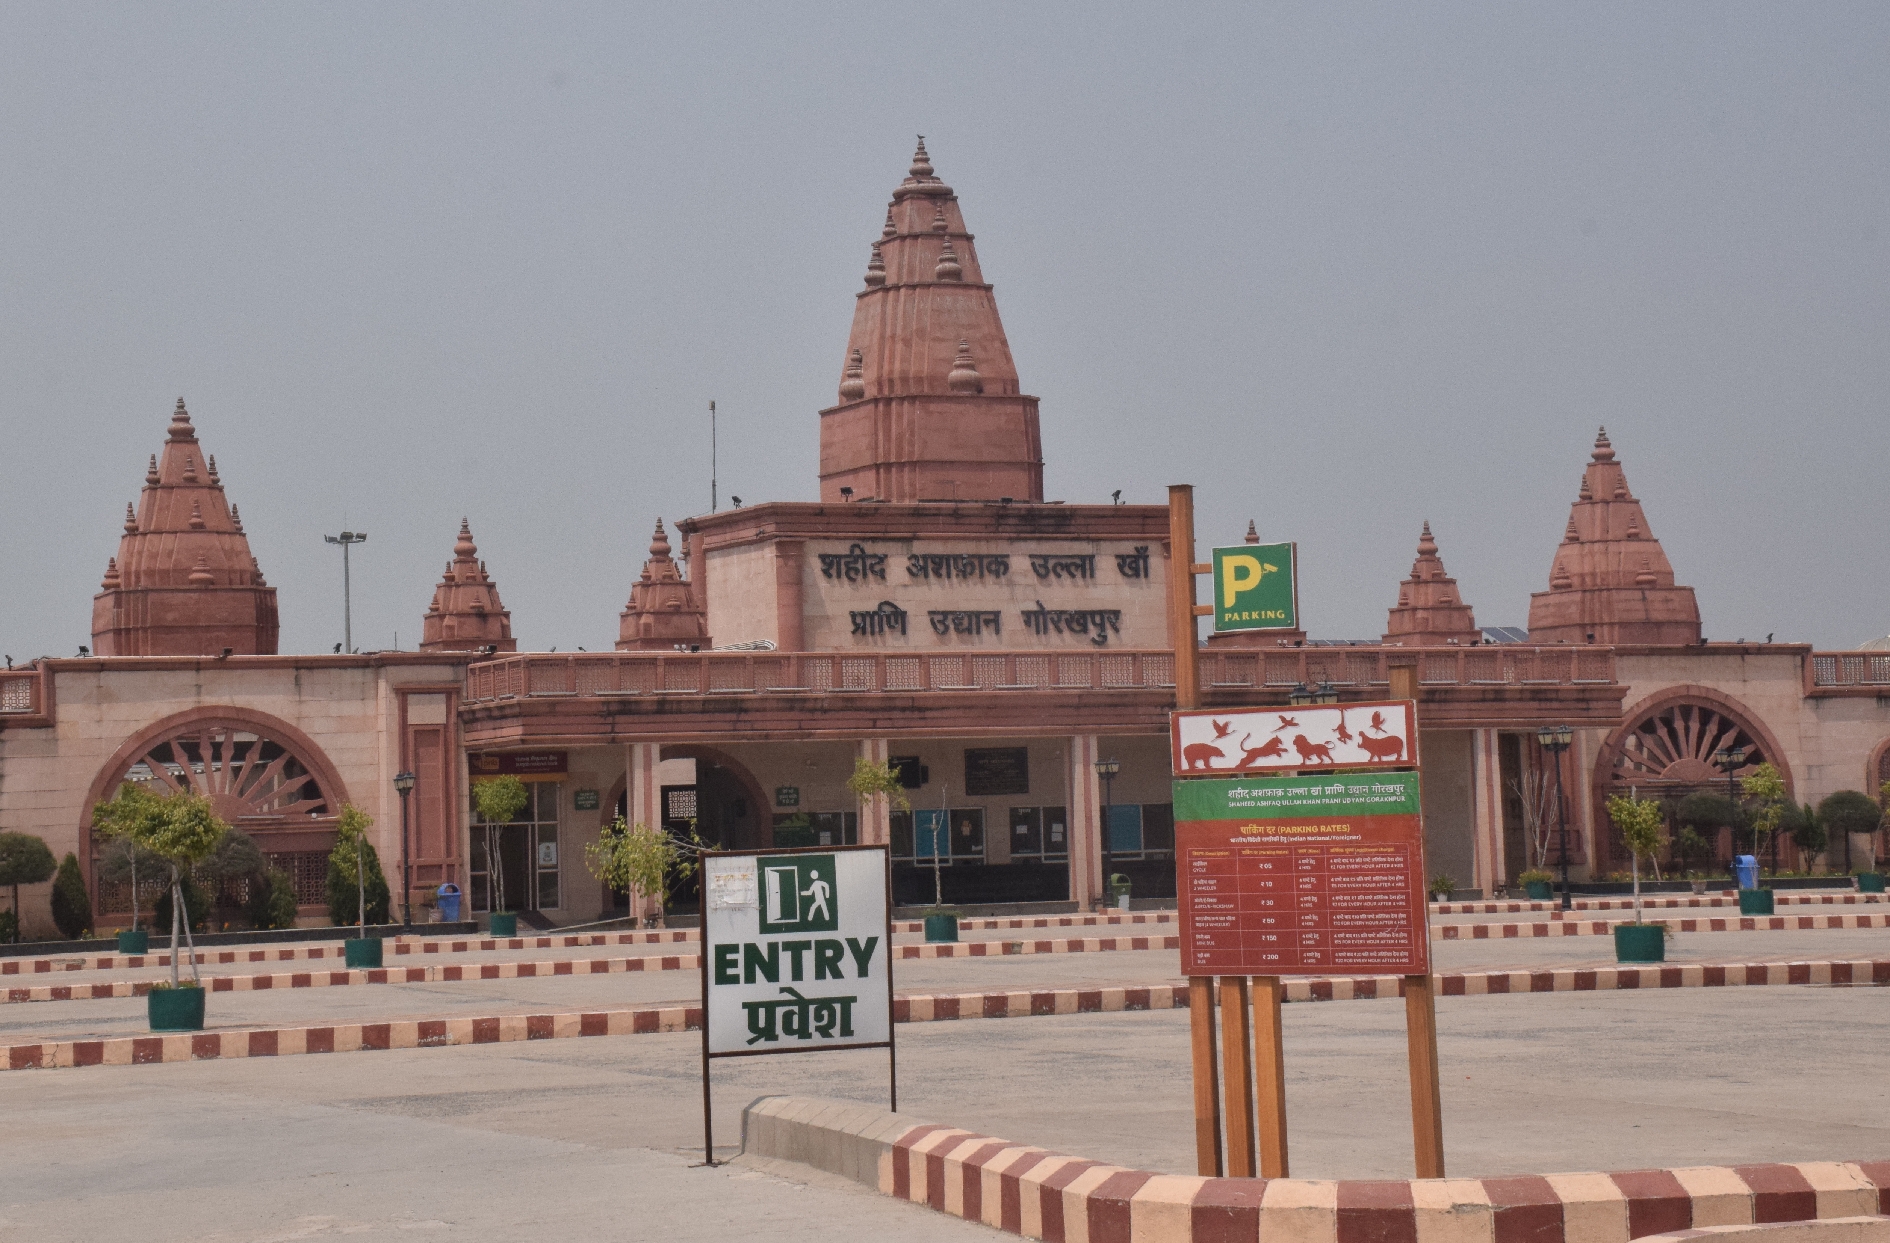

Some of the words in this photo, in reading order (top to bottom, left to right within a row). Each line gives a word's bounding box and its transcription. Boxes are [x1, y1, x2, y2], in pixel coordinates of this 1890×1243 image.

[818, 543, 889, 582] शहीद
[1028, 554, 1095, 579] उल्ला
[1222, 555, 1262, 608] P
[849, 600, 907, 636] प्राणि
[927, 610, 1001, 635] उद्यान
[1021, 599, 1121, 645] गोरखपुर
[1224, 610, 1285, 621] PARKING
[1228, 787, 1249, 799] शहीद
[1287, 787, 1308, 796] उल्ला
[1324, 783, 1345, 795] प्राणि
[1347, 785, 1369, 795] उद्यान
[1371, 782, 1405, 796] गोरखपुर
[1240, 824, 1265, 834] पार्किंग
[1266, 826, 1276, 834] दर
[1278, 825, 1319, 834] (PARKING
[1320, 824, 1350, 833] RATES)
[714, 936, 879, 985] ENTRY
[742, 986, 857, 1045] प्रवेश
